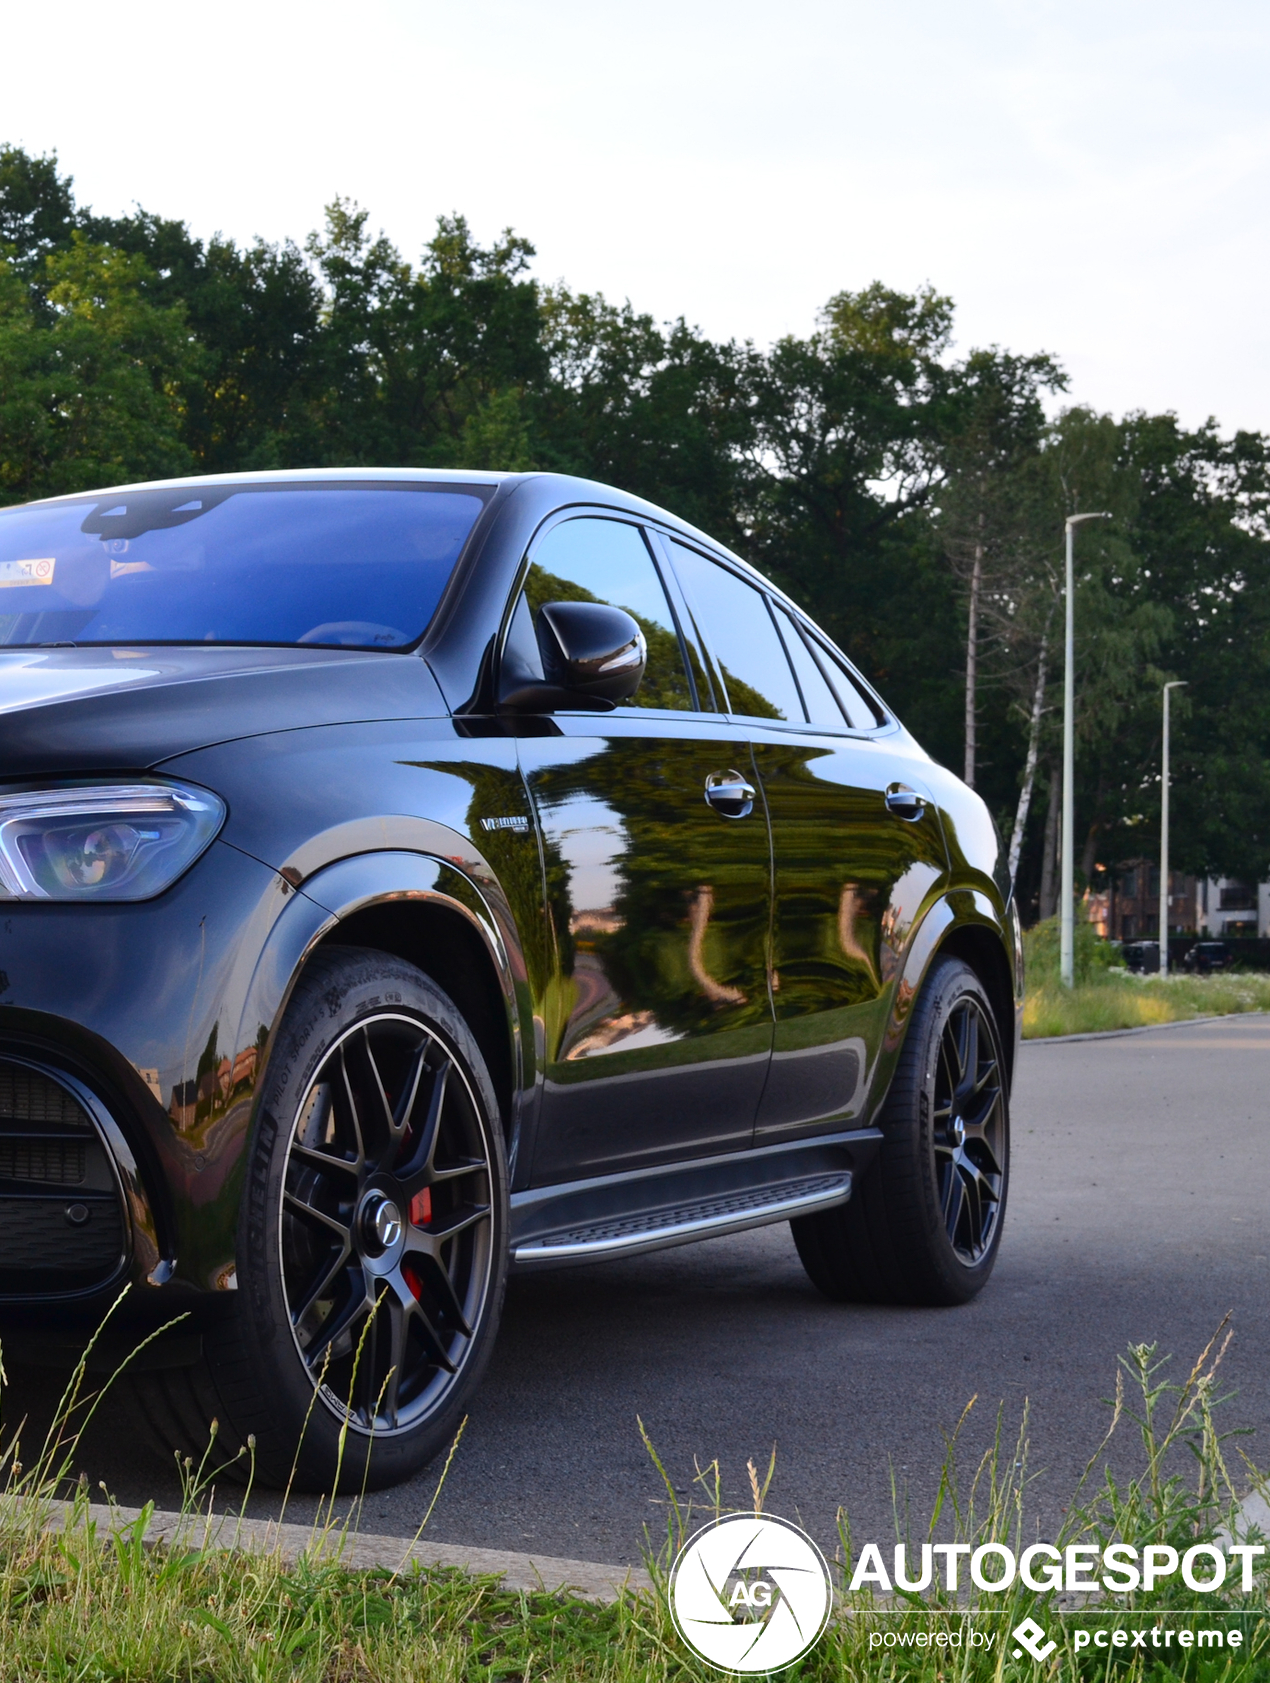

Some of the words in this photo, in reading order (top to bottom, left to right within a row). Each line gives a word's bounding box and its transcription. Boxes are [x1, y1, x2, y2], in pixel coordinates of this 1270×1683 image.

[273, 1064, 292, 1107] PILOT
[290, 1021, 315, 1063] SPORT
[324, 1386, 346, 1411] AMG
